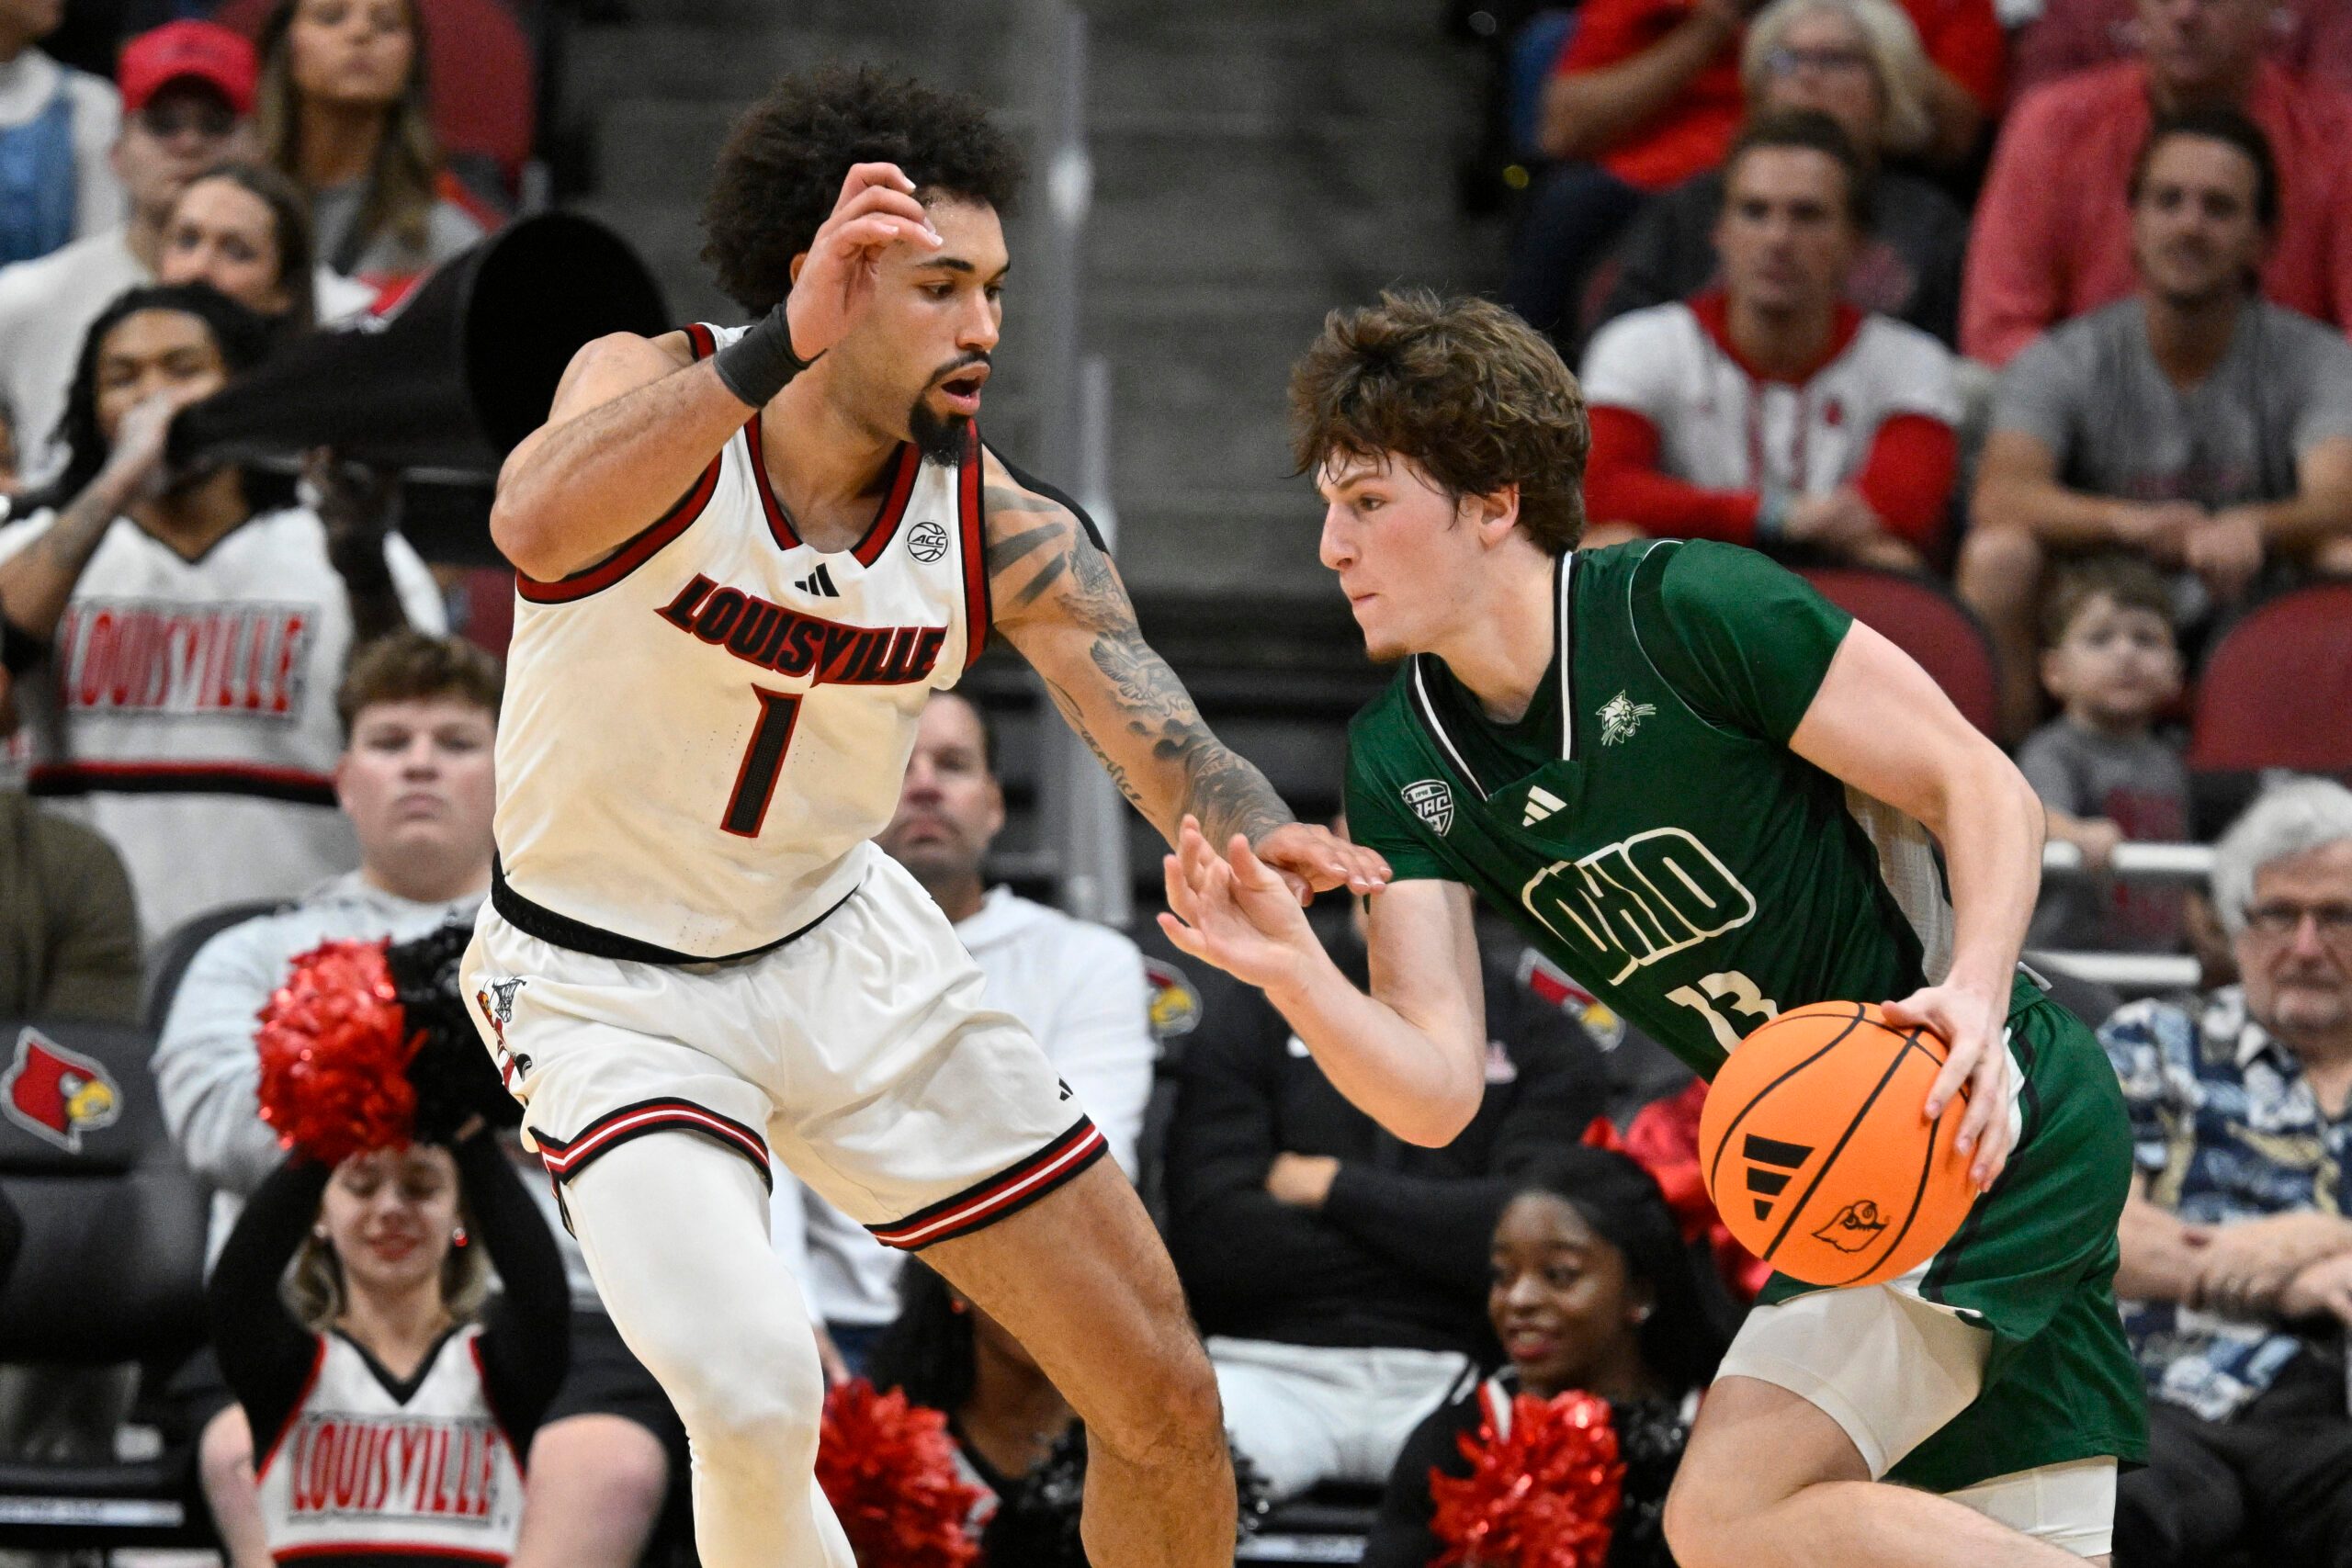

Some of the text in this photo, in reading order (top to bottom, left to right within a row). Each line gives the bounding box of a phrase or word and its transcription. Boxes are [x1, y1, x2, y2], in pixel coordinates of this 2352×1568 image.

[911, 534, 947, 546] ACC
[653, 573, 948, 688] LOUISVILLE
[719, 682, 804, 839] 1
[1521, 827, 1757, 987] OHIO
[293, 1422, 496, 1514] LOUISVILLE
